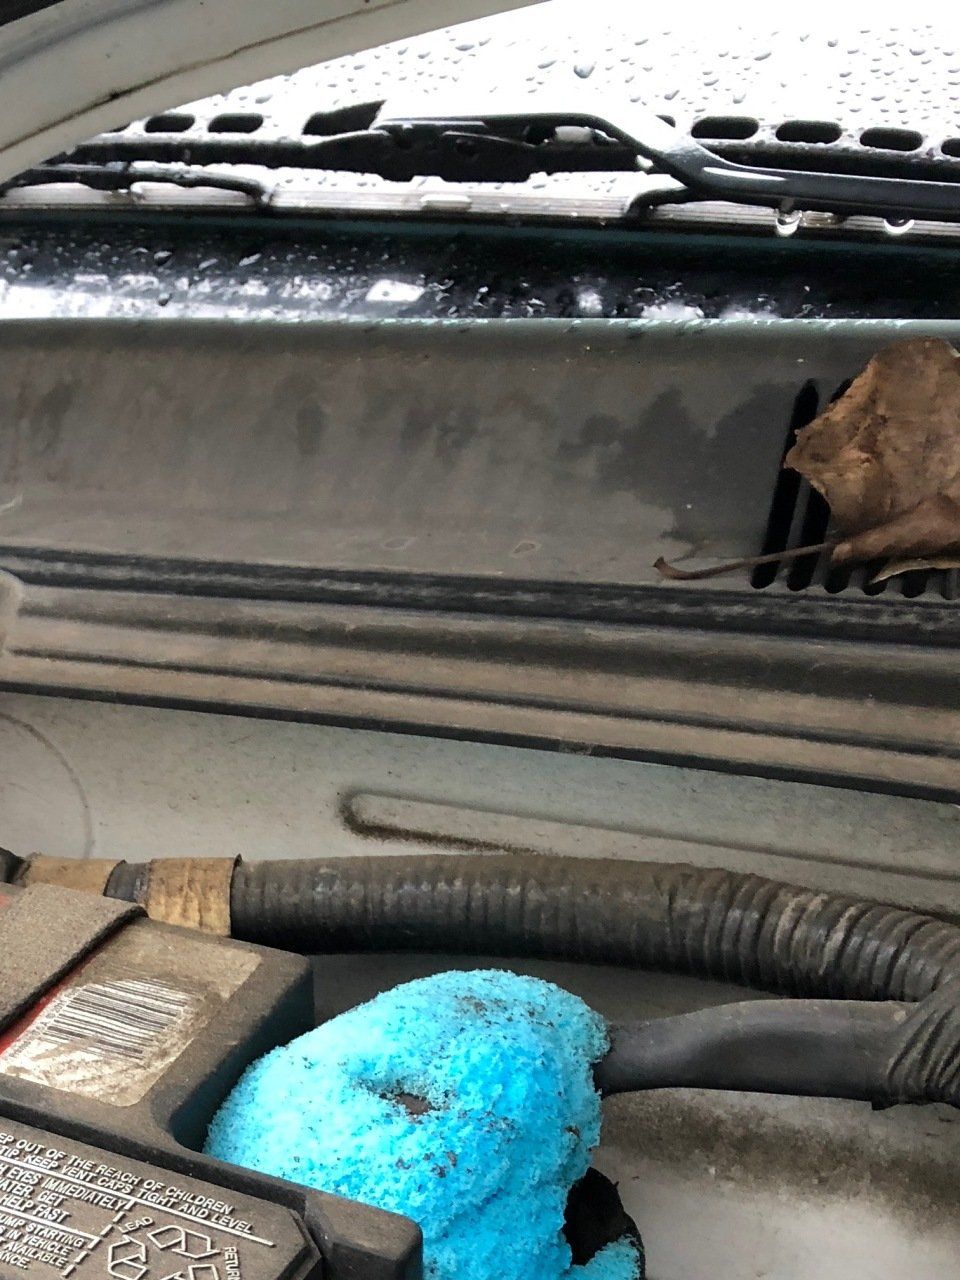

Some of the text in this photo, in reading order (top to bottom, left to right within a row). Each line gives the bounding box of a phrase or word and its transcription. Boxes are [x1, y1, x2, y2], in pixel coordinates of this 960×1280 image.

[7, 1165, 42, 1185] EYES
[43, 1176, 127, 1210] IMMEDIATELY
[17, 1139, 45, 1154] OUT
[47, 1149, 67, 1161] OF
[69, 1155, 95, 1171] THE
[96, 1164, 141, 1185] REACH
[145, 1179, 166, 1192] OF
[166, 1186, 234, 1215] CHILDREN
[25, 1152, 59, 1170] KEEP
[62, 1164, 97, 1182] VENT
[98, 1176, 134, 1194] CAPS
[137, 1189, 176, 1208] TIGHT
[179, 1202, 209, 1218] AND
[212, 1213, 254, 1234] LEVEL
[40, 1191, 69, 1207] GET
[0, 1194, 35, 1212] HELP
[34, 1203, 70, 1223] FAST
[26, 1222, 85, 1248] STARTING
[118, 1216, 154, 1234] LEAD
[5, 1241, 68, 1267] AVAILABLE
[7, 1229, 22, 1240] IN
[23, 1234, 73, 1256] VEHICLE
